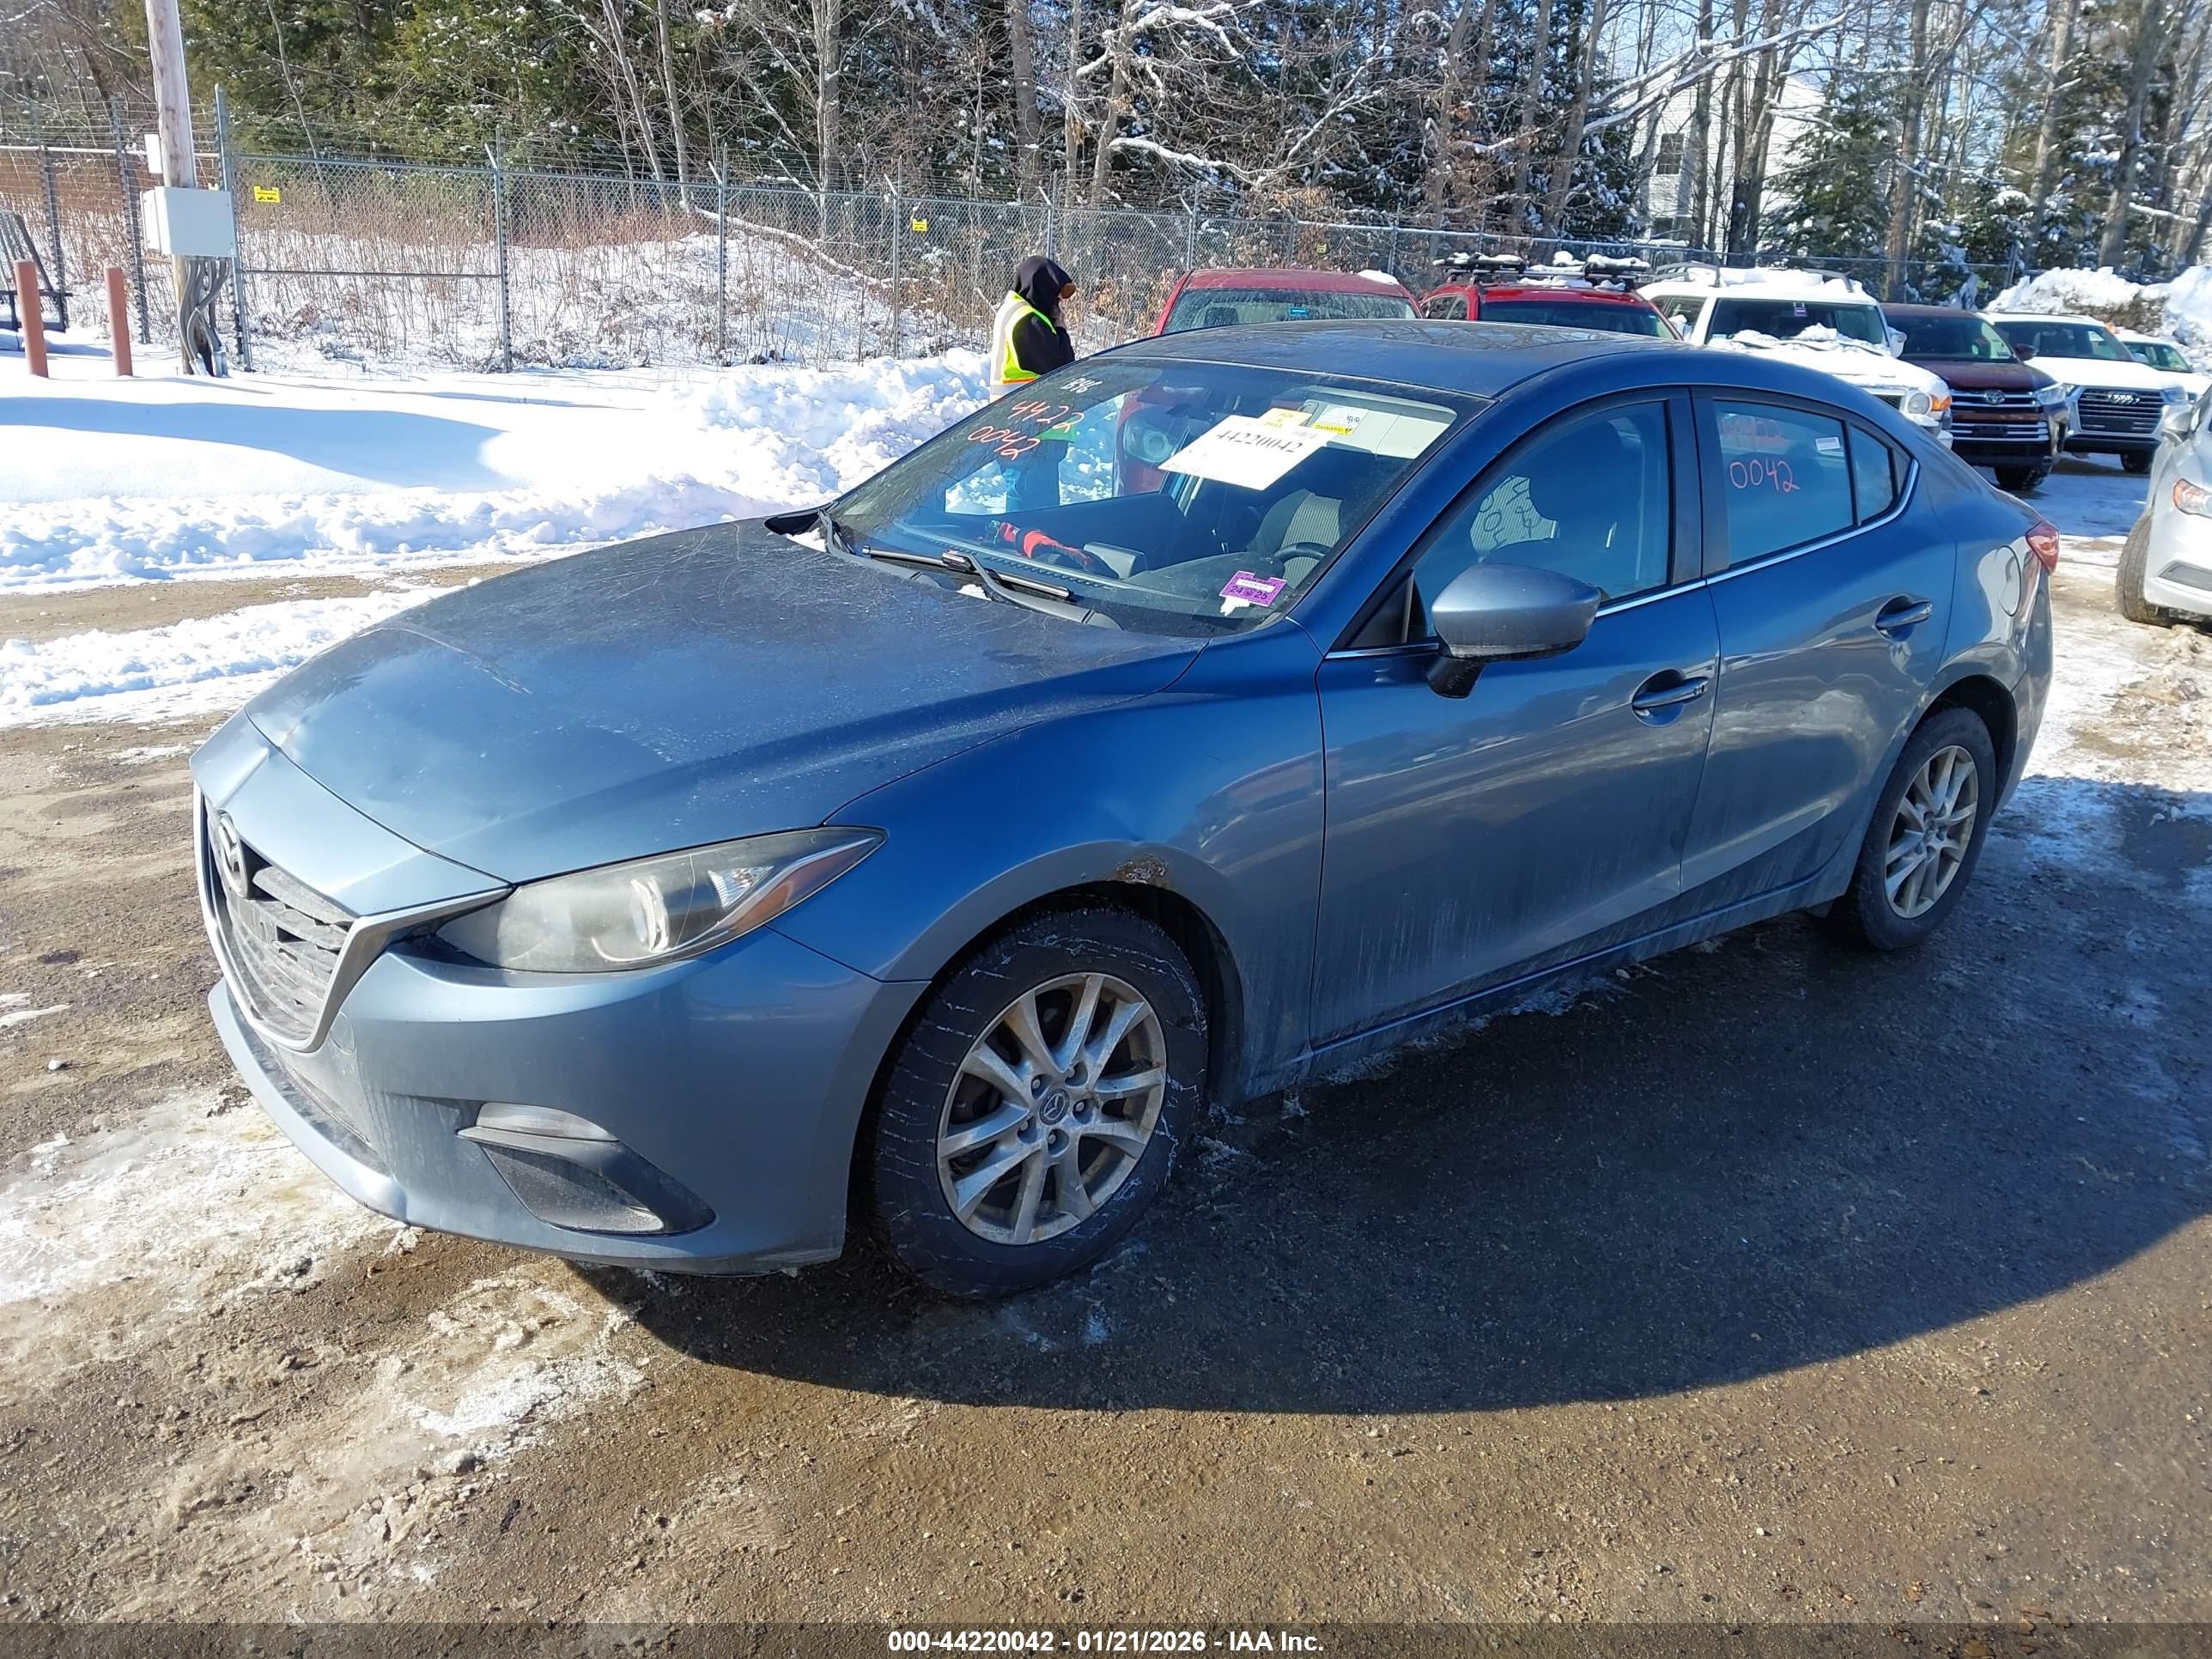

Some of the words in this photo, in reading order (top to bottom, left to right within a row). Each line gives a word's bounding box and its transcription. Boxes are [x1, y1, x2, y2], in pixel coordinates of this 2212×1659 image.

[1007, 400, 1085, 434] 4422
[967, 425, 1041, 461] 0042
[1217, 429, 1304, 453] 44220042
[1729, 457, 1801, 493] 0042
[1229, 585, 1244, 594] 24
[1254, 591, 1270, 600] 25
